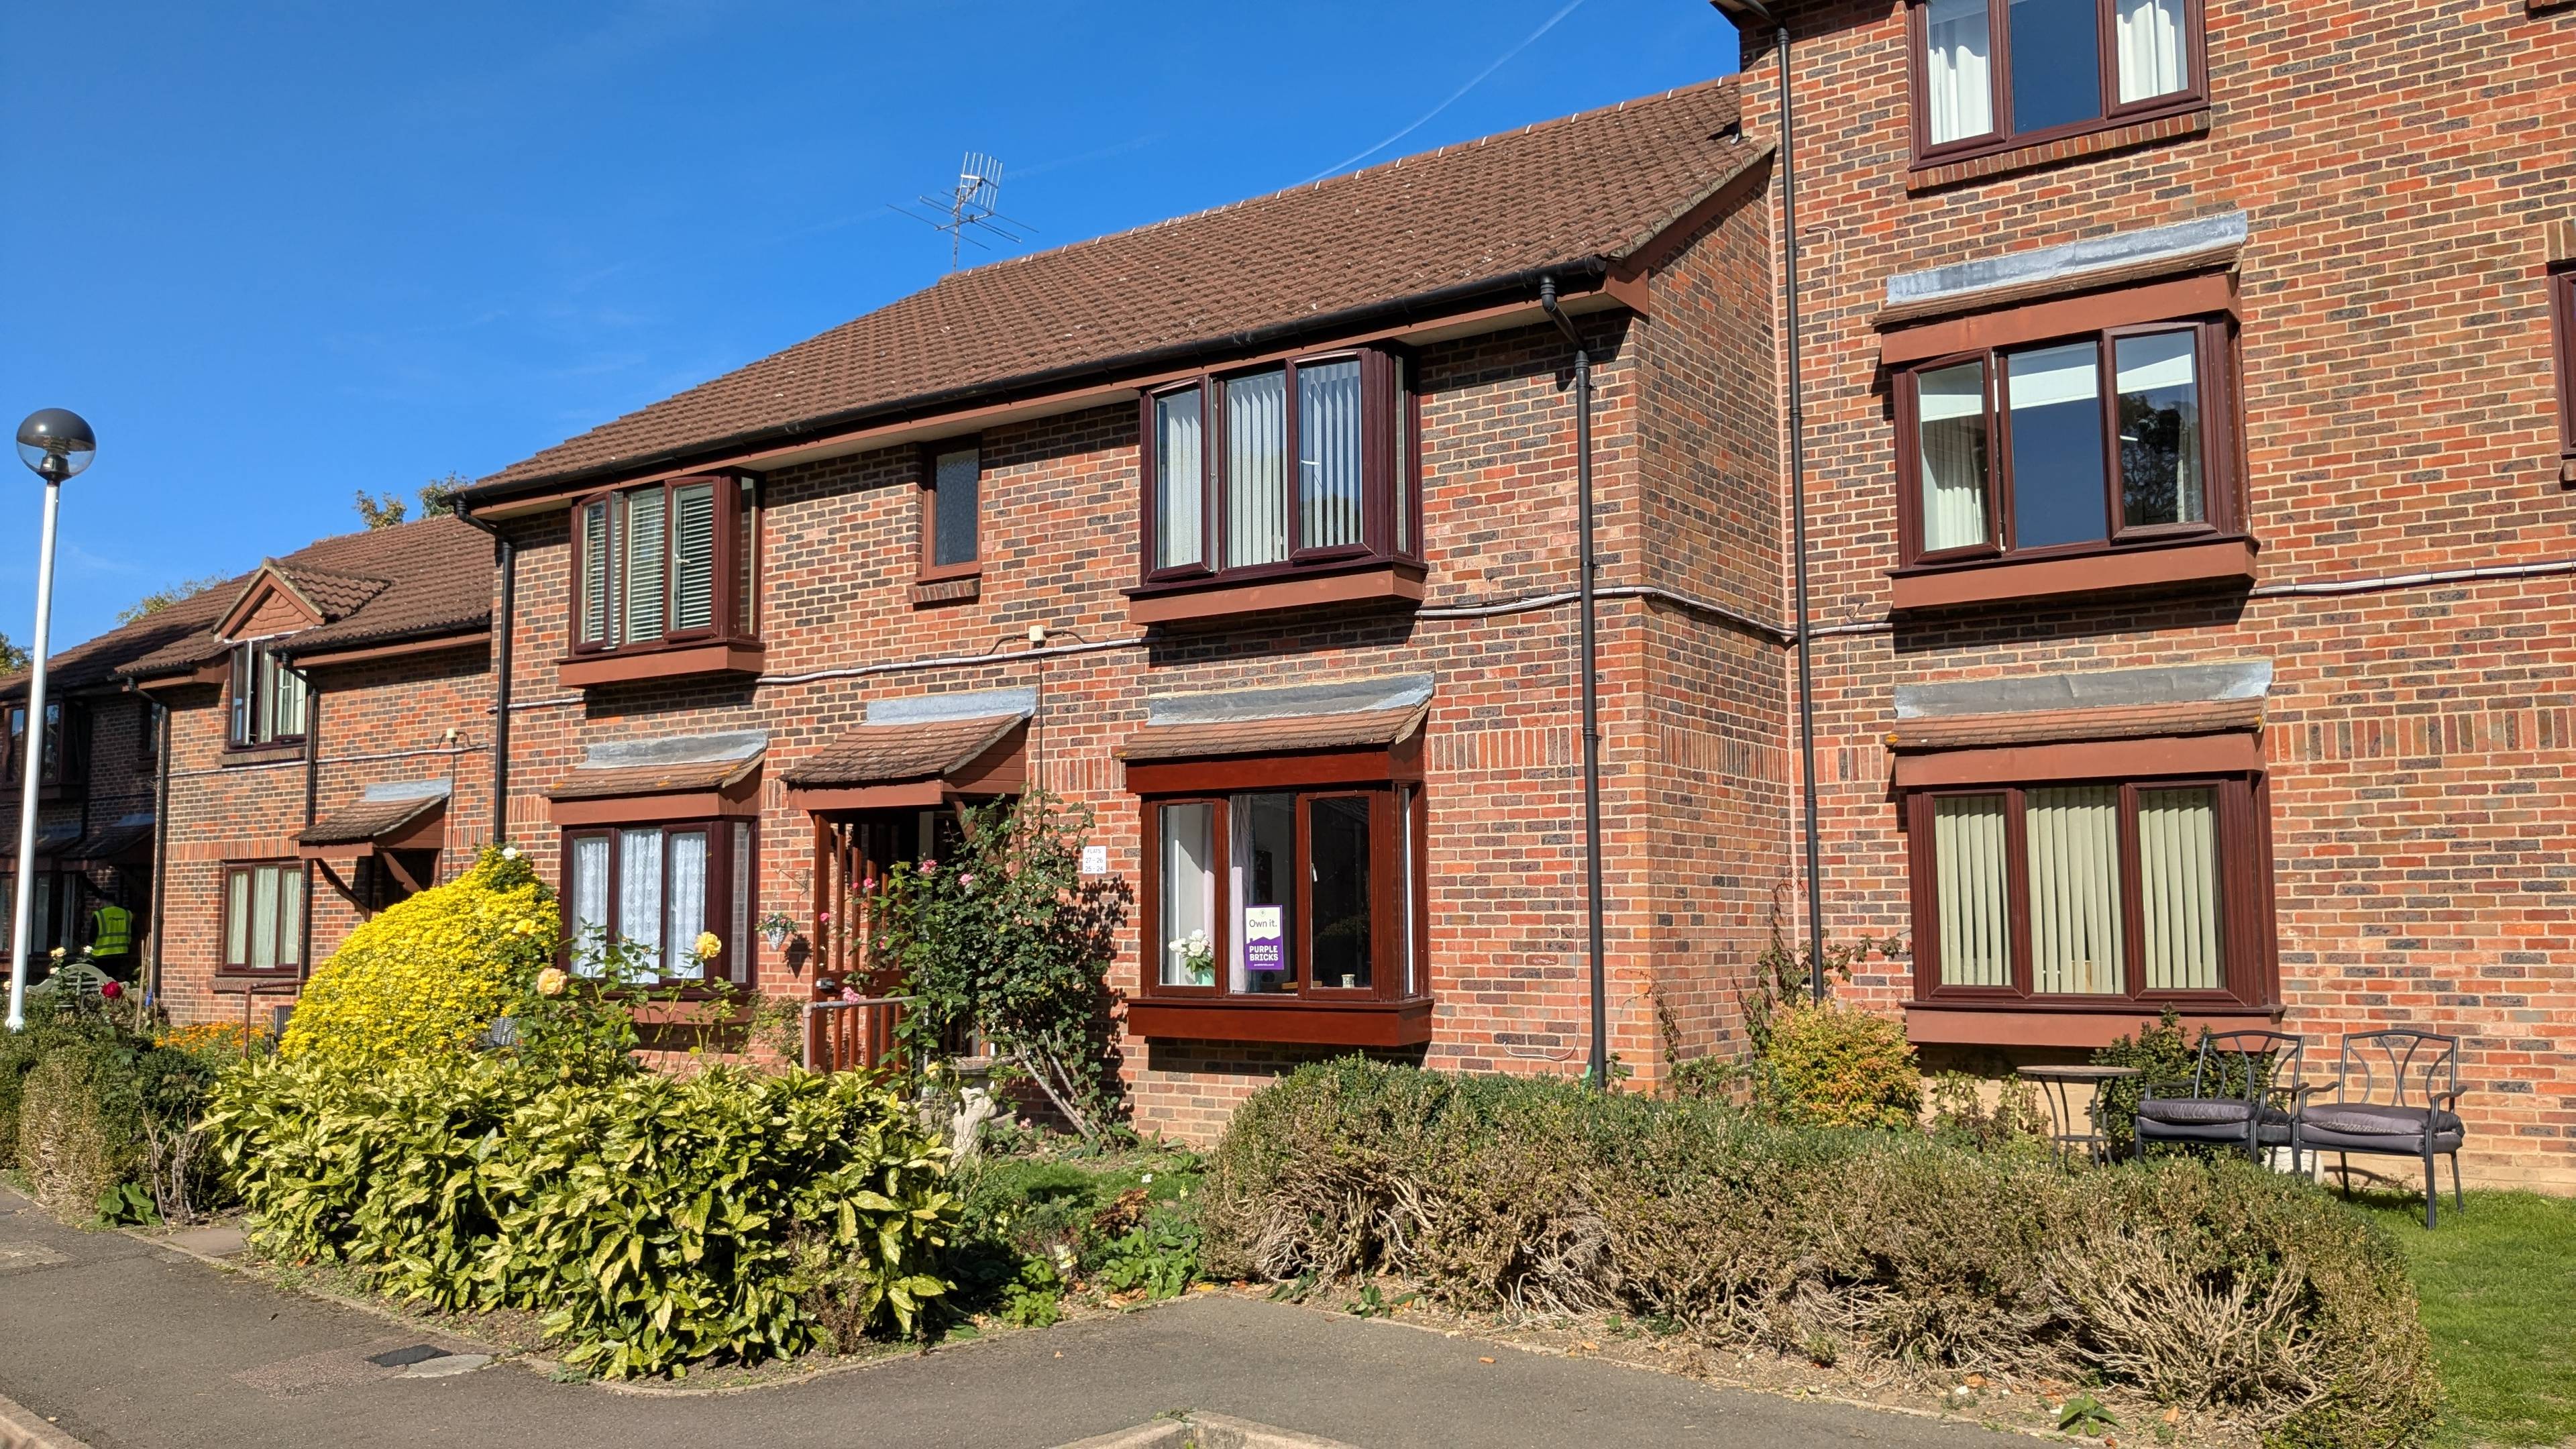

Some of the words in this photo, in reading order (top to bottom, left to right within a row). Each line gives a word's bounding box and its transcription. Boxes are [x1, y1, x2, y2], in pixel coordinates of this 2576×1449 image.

[1249, 919, 1267, 928] Own
[1269, 919, 1277, 928] it.
[1249, 945, 1278, 953] PURPLE
[1250, 953, 1279, 961] BRICKS
